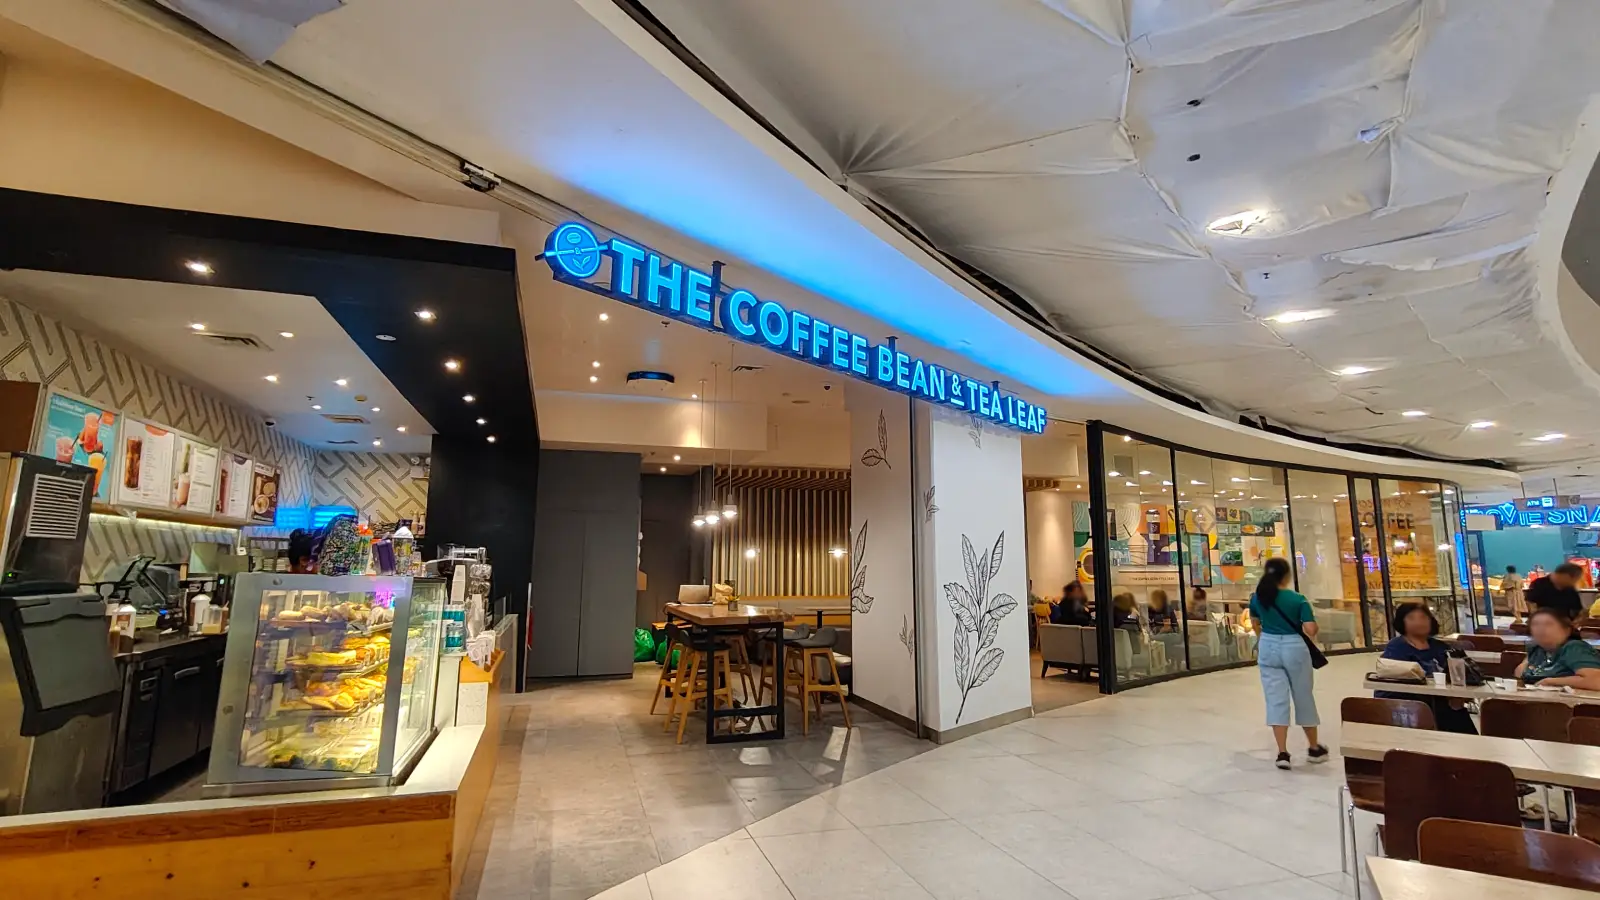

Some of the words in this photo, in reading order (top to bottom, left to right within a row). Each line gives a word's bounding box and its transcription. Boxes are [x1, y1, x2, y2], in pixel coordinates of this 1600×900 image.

[612, 239, 712, 322] THE
[729, 290, 867, 375] COFFEE
[878, 345, 945, 401] BEAN
[951, 374, 962, 399] &
[966, 379, 1004, 421] TEA
[1008, 396, 1046, 433] LEAF
[1527, 499, 1540, 507] ATM
[1357, 511, 1416, 529] OFEE
[1478, 502, 1542, 526] OVIE
